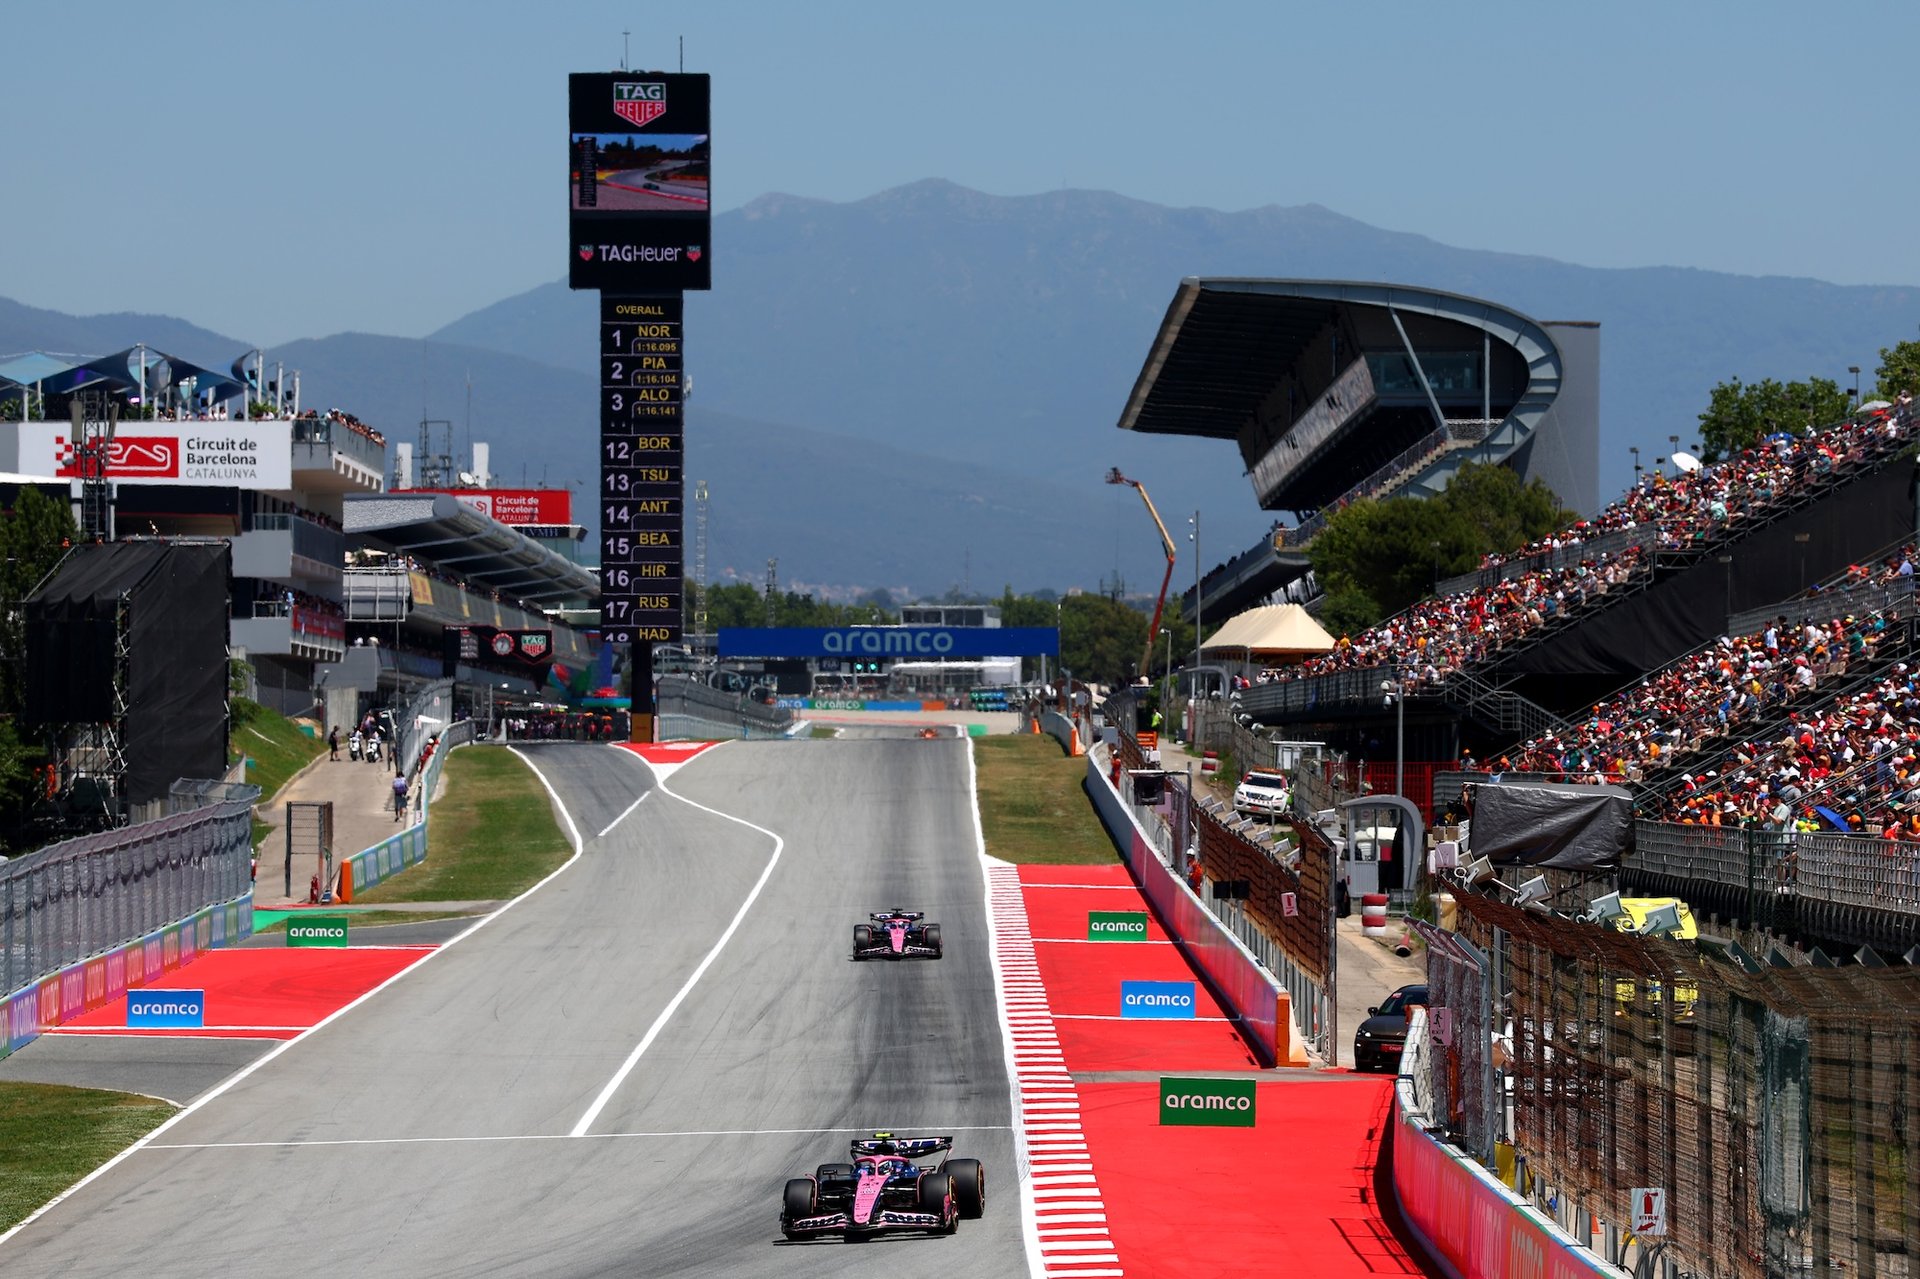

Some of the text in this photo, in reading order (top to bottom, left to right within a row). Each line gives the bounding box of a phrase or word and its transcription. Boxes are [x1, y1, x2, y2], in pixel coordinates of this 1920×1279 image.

[618, 85, 661, 100] TAG
[616, 103, 663, 123] HEUER
[616, 305, 664, 315] OVERALL
[612, 325, 670, 347] 1 NOR
[611, 357, 667, 379] 2 PIA
[637, 375, 676, 383] 1:16.104
[612, 389, 670, 411] 3 ALO
[637, 407, 676, 415] 1:16.141
[187, 437, 257, 450] Circuit de
[606, 437, 670, 459] 12 BOR
[187, 453, 257, 465] Barcelona
[186, 468, 257, 479] CATALUNYA
[606, 469, 669, 491] 13 TSU
[496, 496, 526, 505] Circuit
[606, 501, 669, 523] 14 ANT
[606, 533, 670, 555] 15 BEA
[606, 565, 667, 587] 16 HIR
[605, 597, 669, 618] 17 RUS
[525, 636, 544, 644] TAG
[639, 628, 670, 640] HAD
[823, 631, 953, 652] aramco
[814, 700, 861, 709] aramco
[290, 927, 344, 937] aramco
[1092, 921, 1144, 932] aramco
[1125, 994, 1191, 1006] aramco
[131, 1002, 199, 1015] aramco
[1165, 1094, 1251, 1111] aramco
